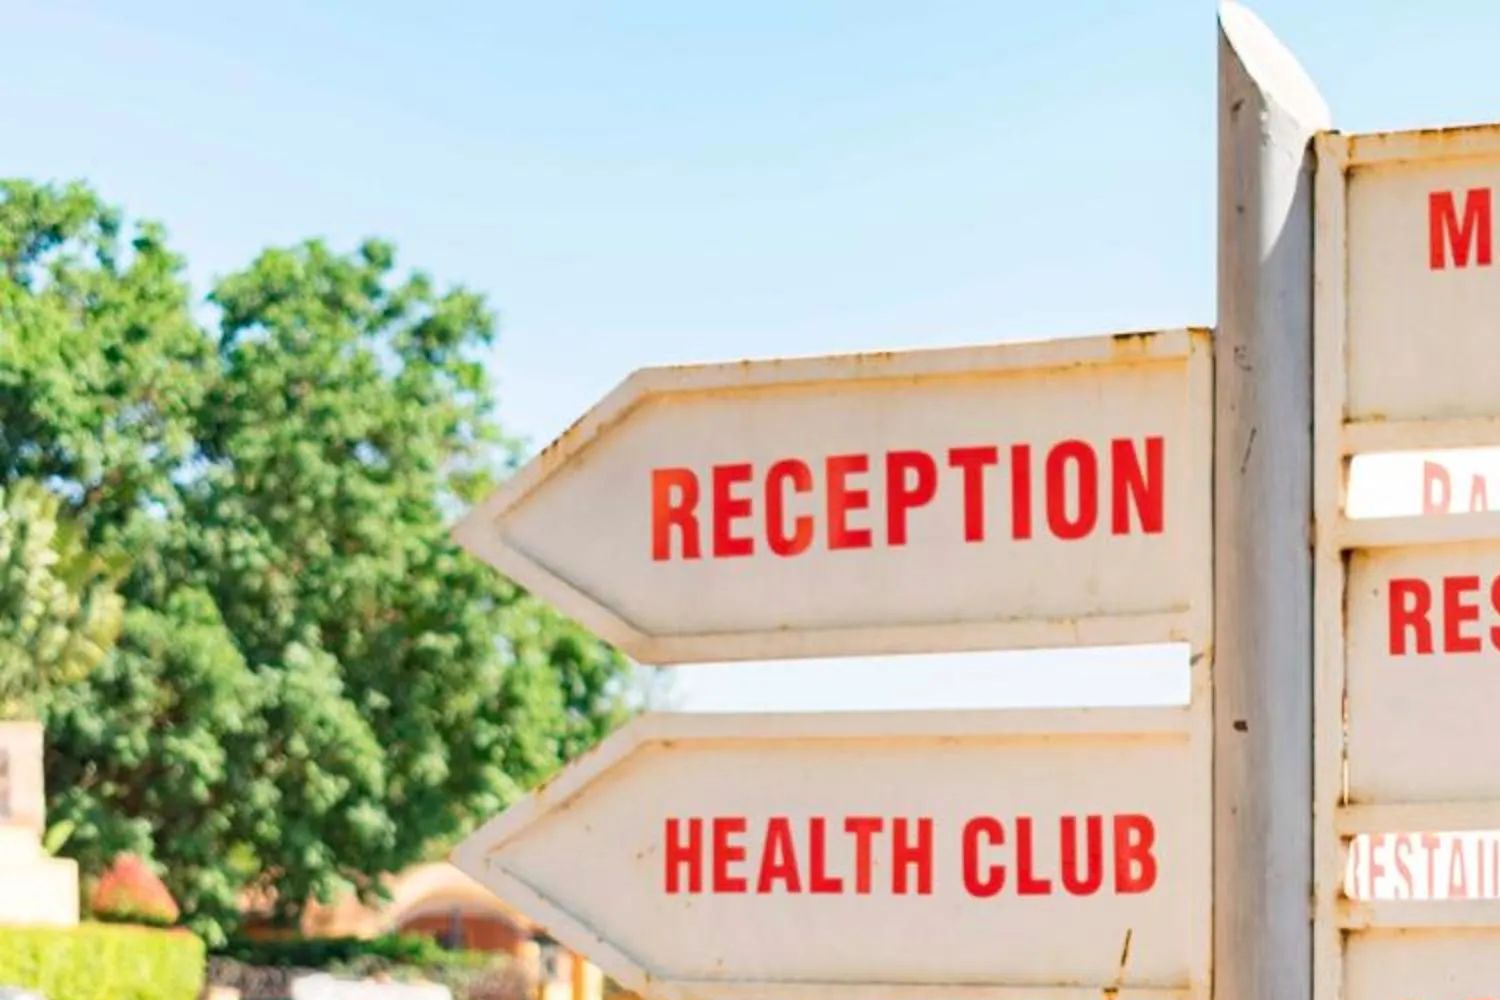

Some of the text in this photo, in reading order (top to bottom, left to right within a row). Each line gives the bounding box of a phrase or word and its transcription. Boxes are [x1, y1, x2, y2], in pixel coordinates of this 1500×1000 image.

[652, 436, 1164, 561] RECEPTION
[664, 814, 1157, 897] HEALTH CLUB
